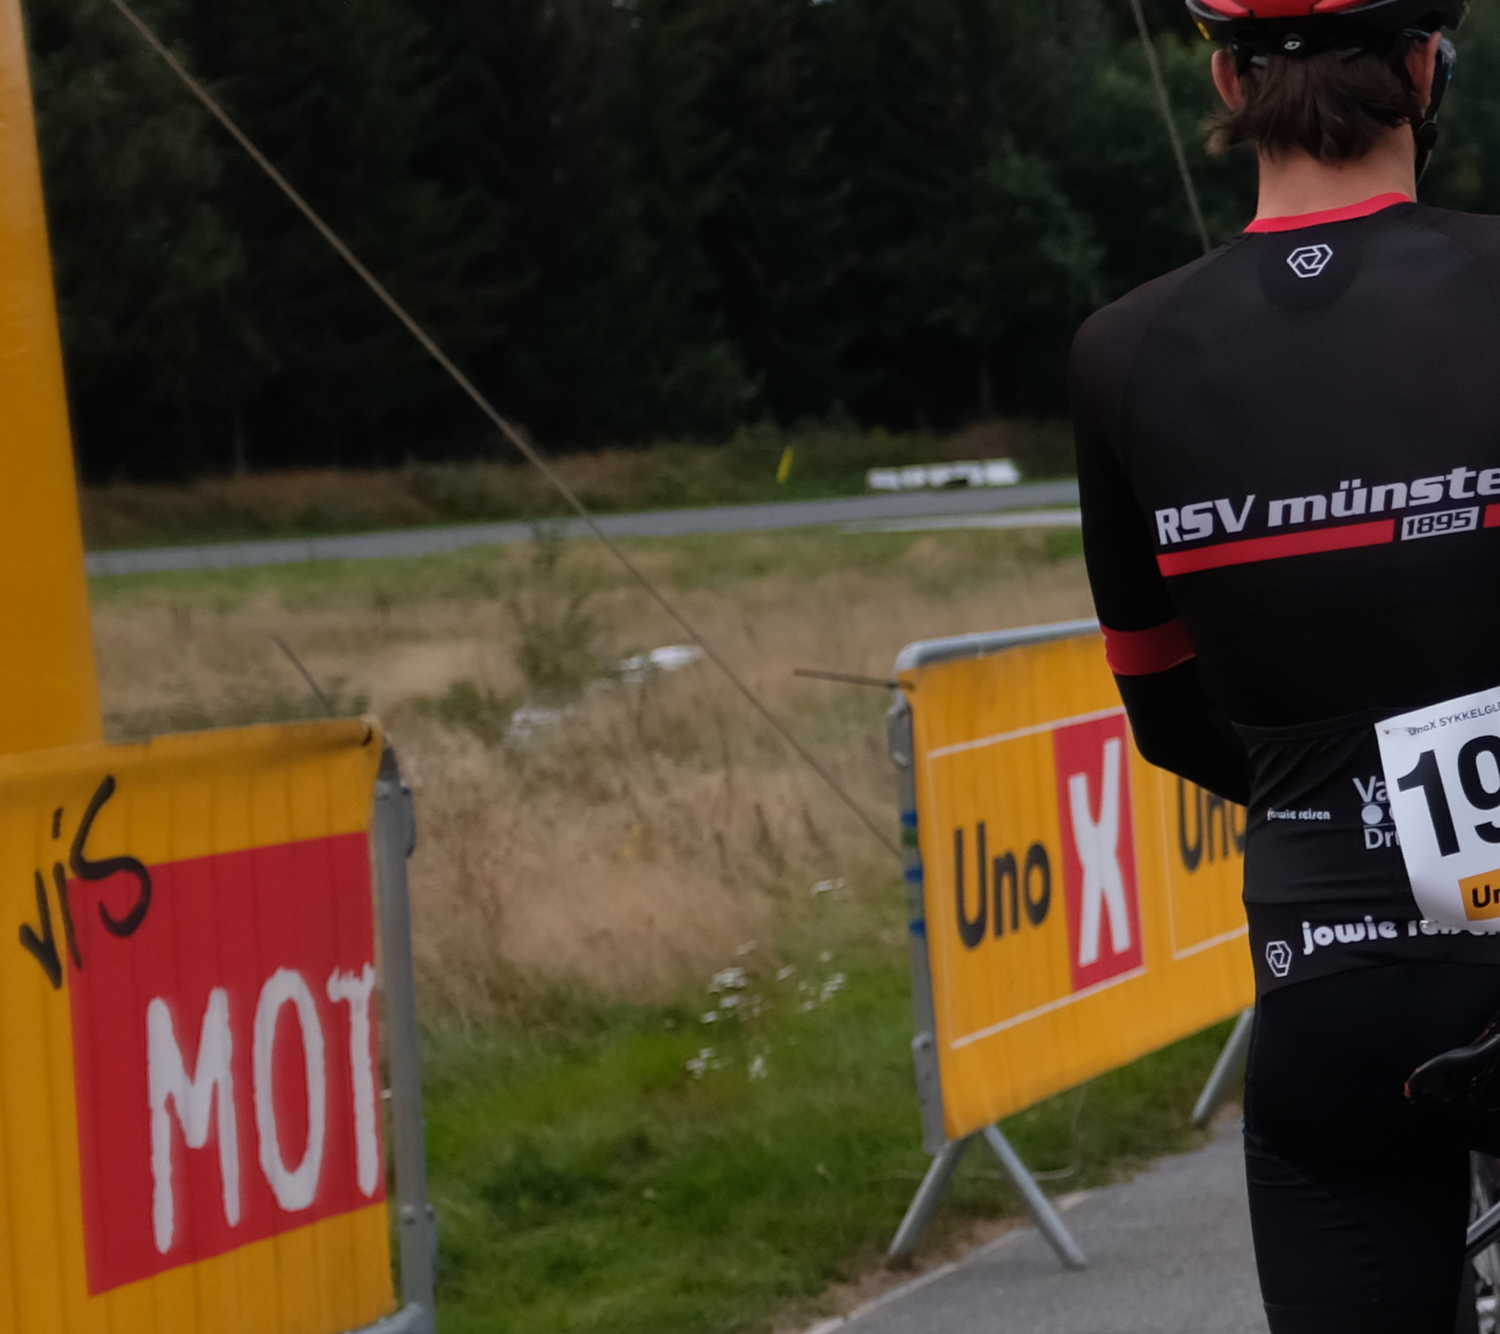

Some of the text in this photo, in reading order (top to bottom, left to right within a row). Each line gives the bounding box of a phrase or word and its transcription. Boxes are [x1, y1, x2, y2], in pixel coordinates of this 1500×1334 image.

[1155, 493, 1256, 547] RSV
[1402, 508, 1476, 536] 1895
[954, 737, 1132, 969] Uno X
[1302, 915, 1398, 956] jowie
[147, 963, 381, 1256] MOT
